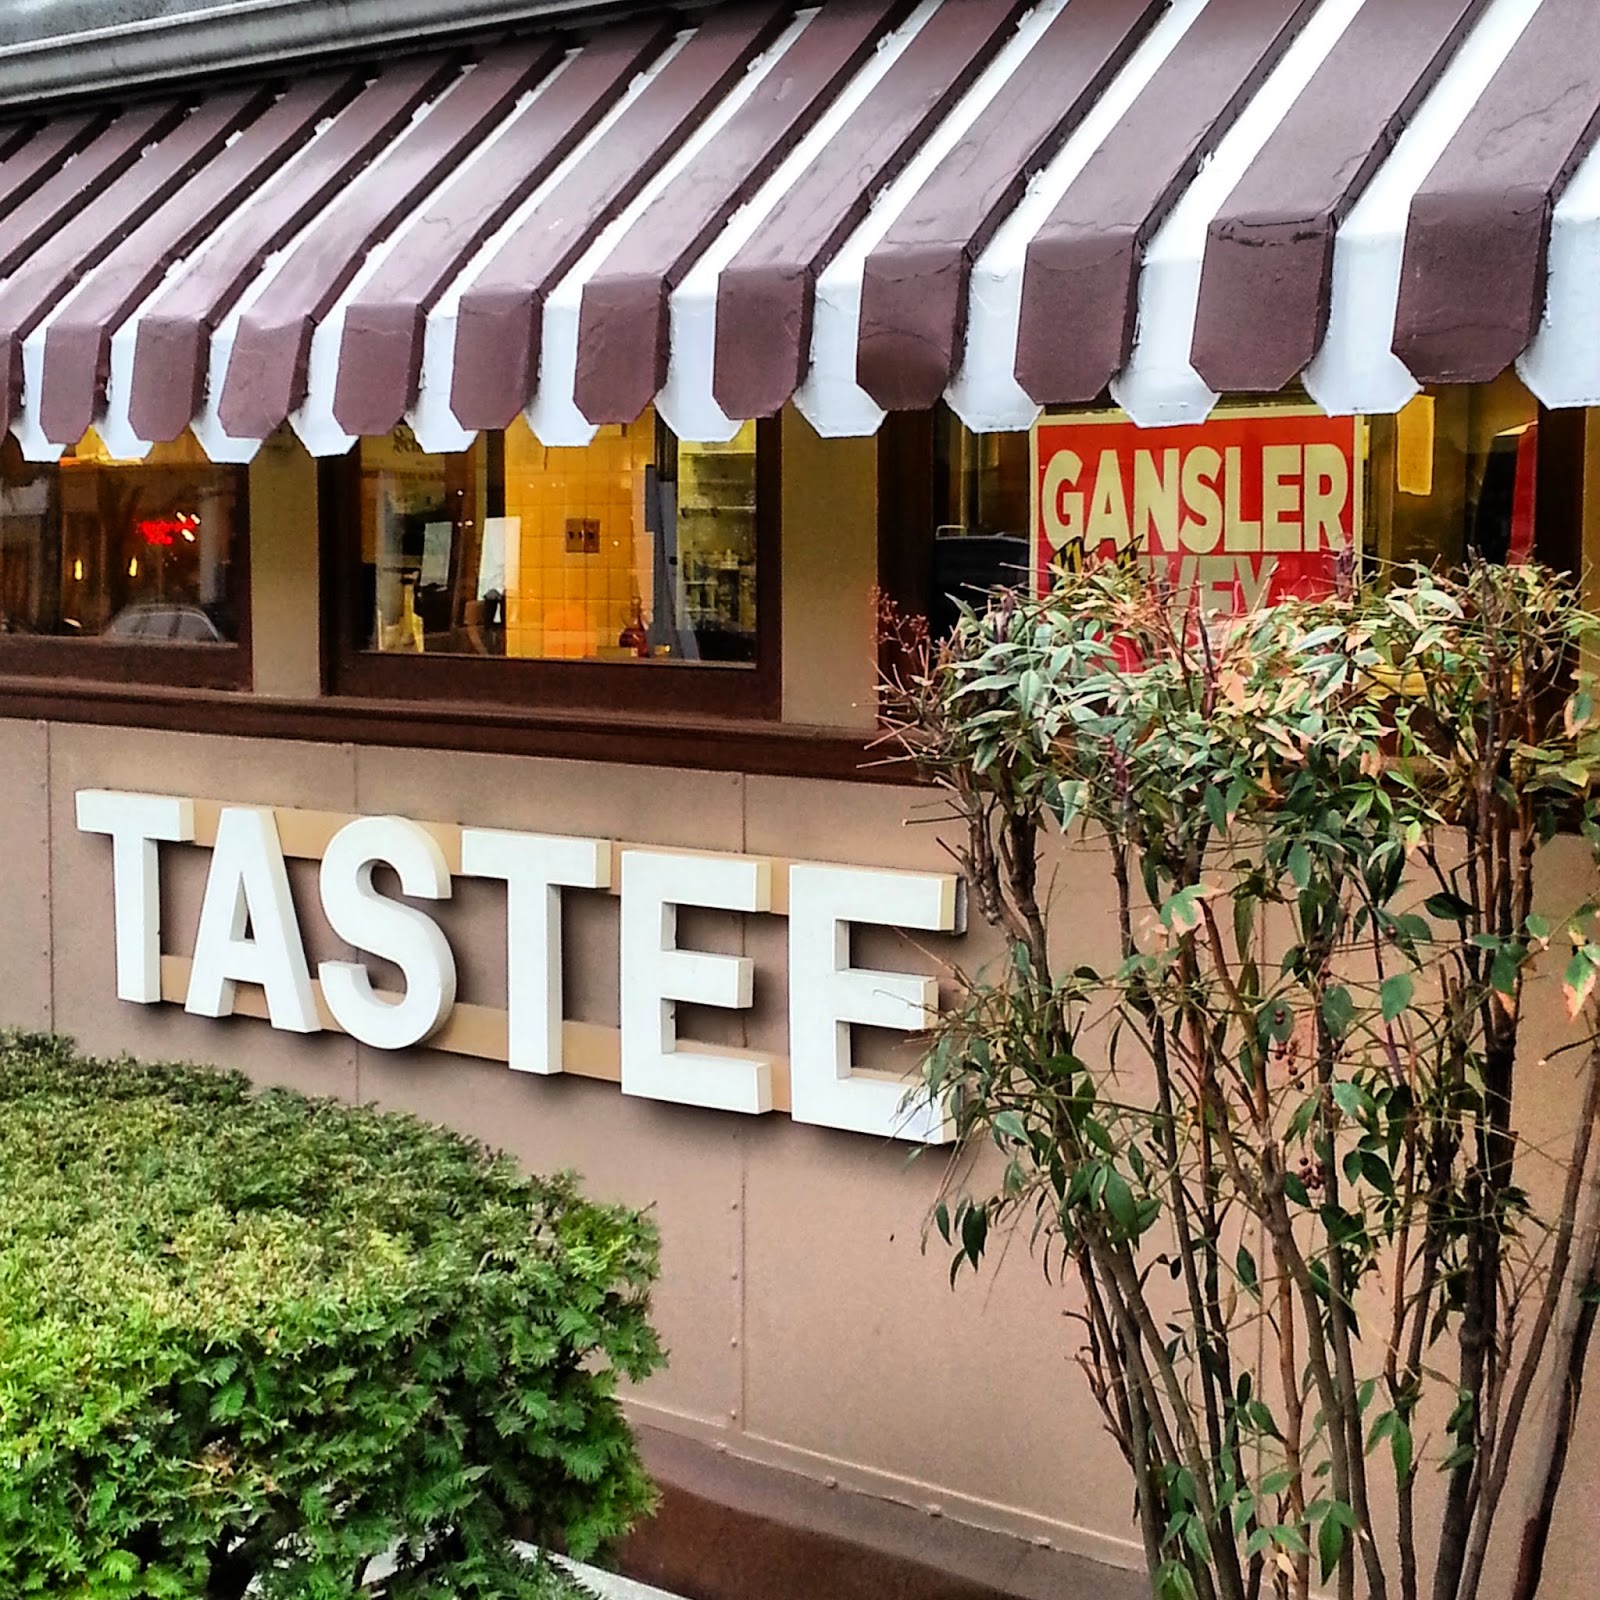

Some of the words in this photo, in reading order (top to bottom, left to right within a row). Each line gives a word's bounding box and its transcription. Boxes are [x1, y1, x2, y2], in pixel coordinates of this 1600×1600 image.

[1042, 445, 1349, 554] GANSLER
[1138, 555, 1278, 640] VEY
[76, 789, 959, 1145] TASTEE
